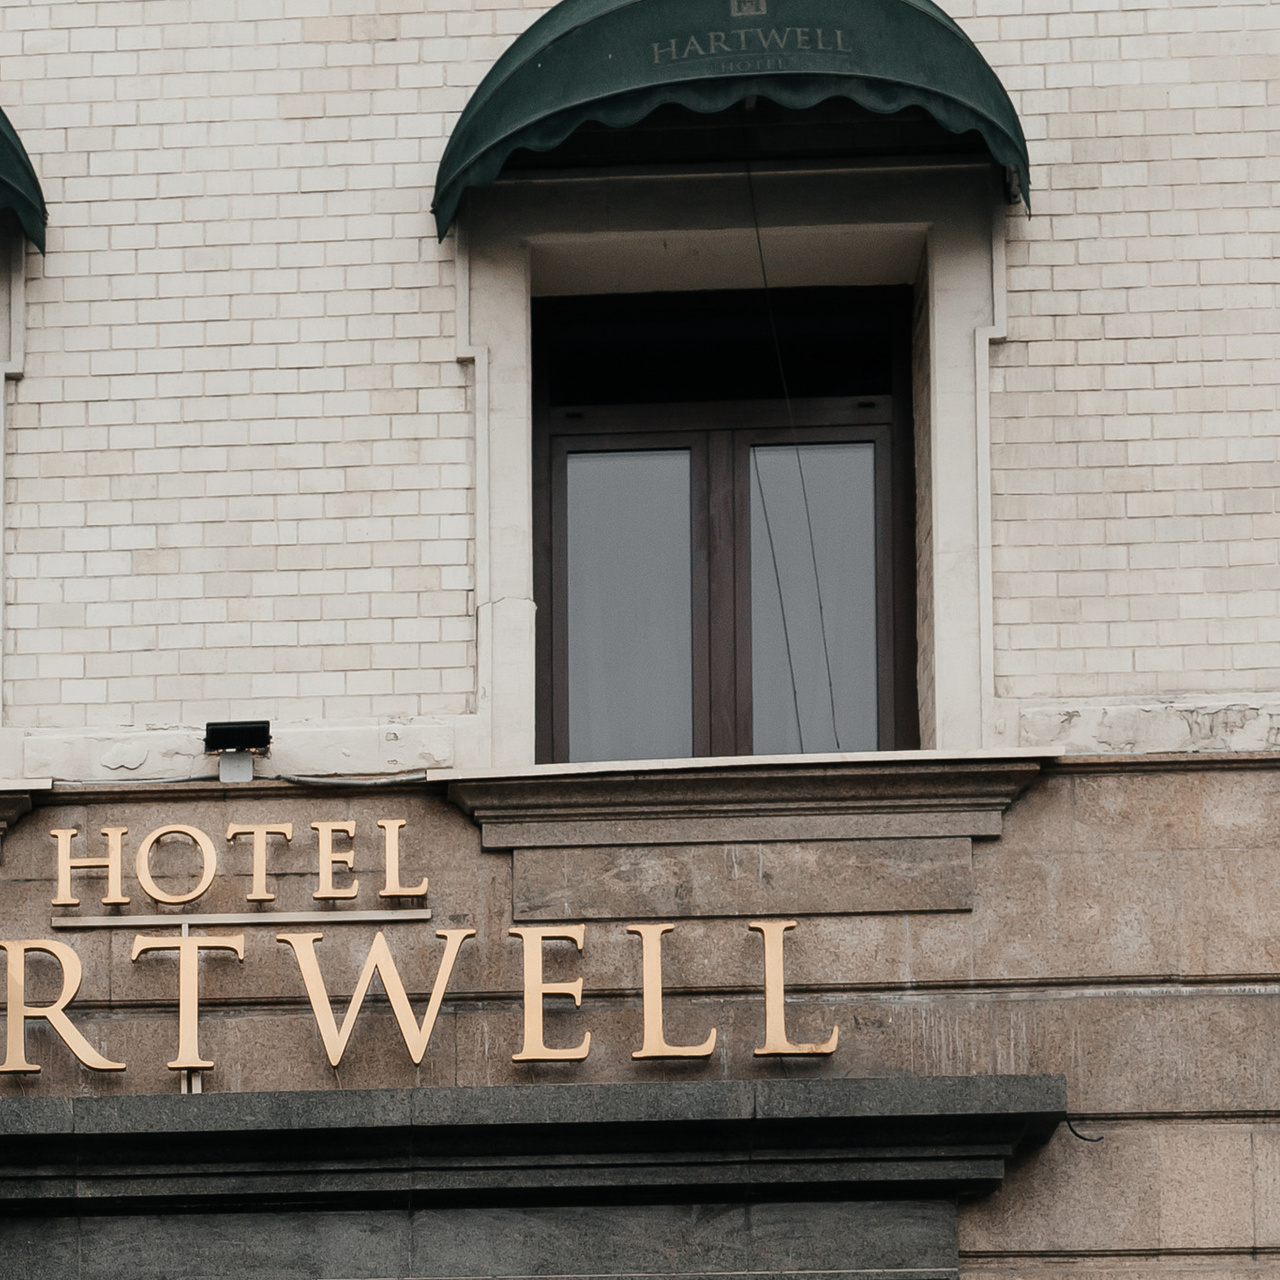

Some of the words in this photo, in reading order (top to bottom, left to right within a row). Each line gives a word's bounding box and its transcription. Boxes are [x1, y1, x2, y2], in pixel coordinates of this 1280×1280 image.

[652, 28, 852, 64] HARTWELL
[721, 58, 787, 72] HOTEL
[50, 818, 430, 908] HOTEL
